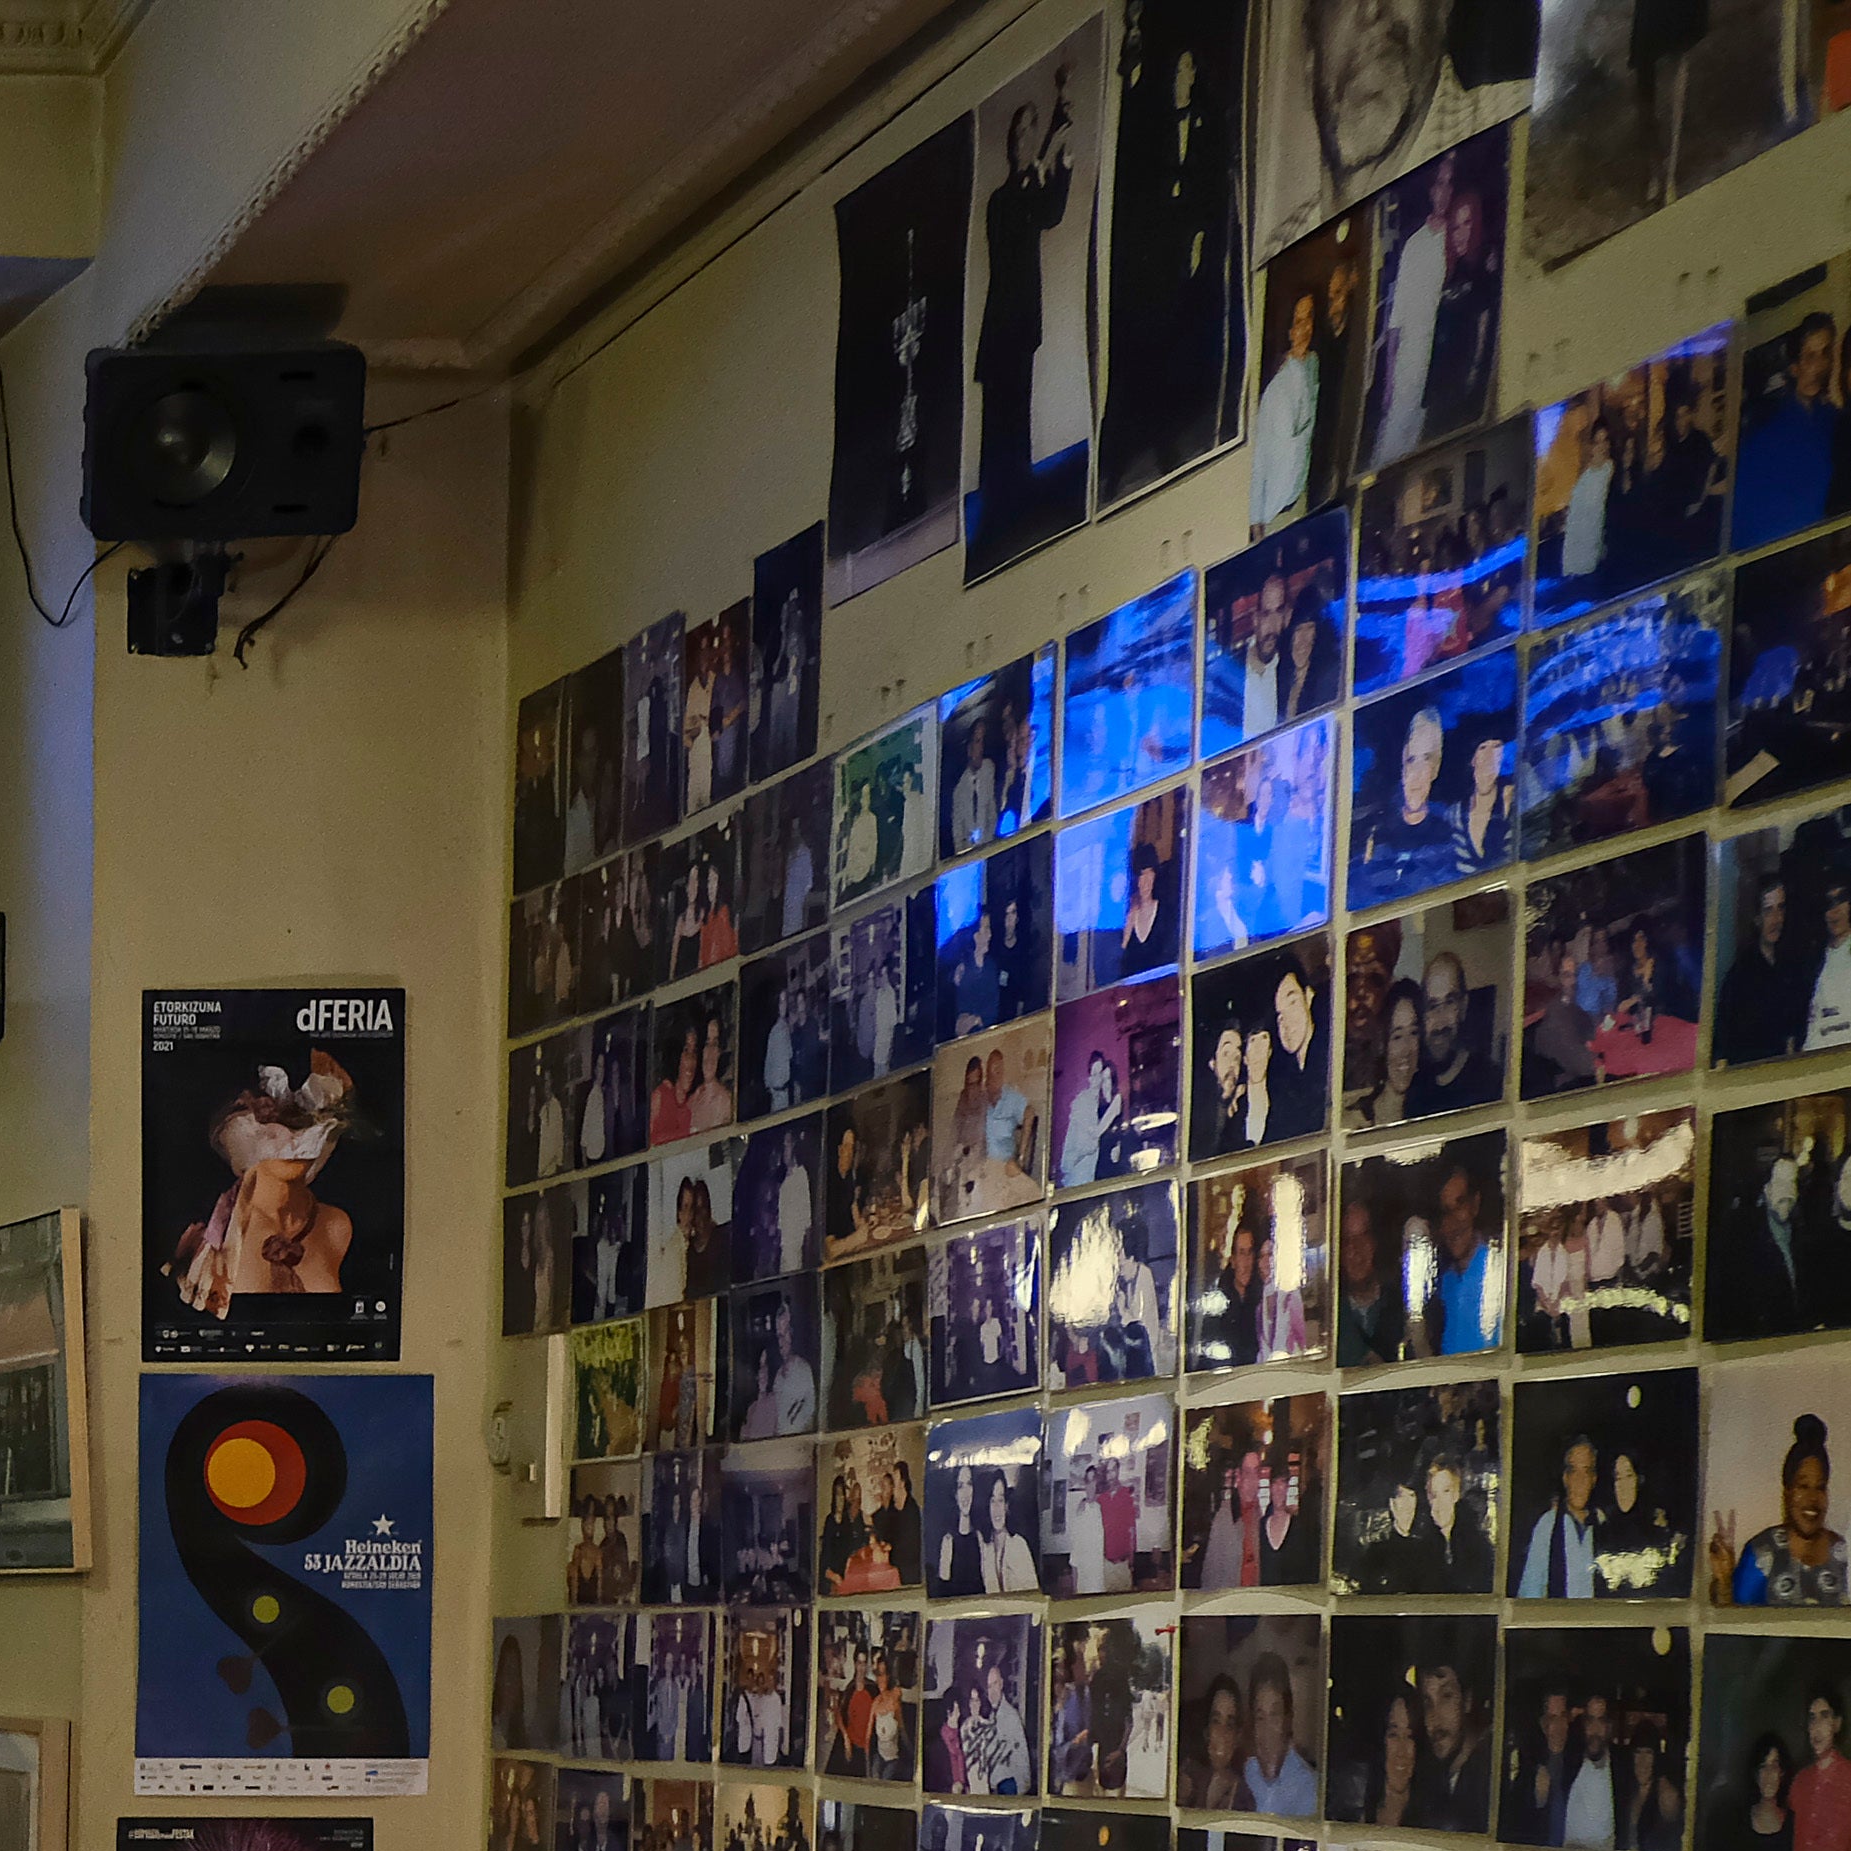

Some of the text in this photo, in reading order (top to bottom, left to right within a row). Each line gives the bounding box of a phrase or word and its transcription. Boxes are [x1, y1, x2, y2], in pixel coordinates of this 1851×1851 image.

[153, 1000, 222, 1013] ETORKIZUNA
[153, 1013, 196, 1026] FUTURO
[296, 999, 394, 1032] dFERIA
[152, 1041, 174, 1051] 2021
[345, 1540, 421, 1554] Heineken
[323, 1554, 422, 1573] JAZZALDIA
